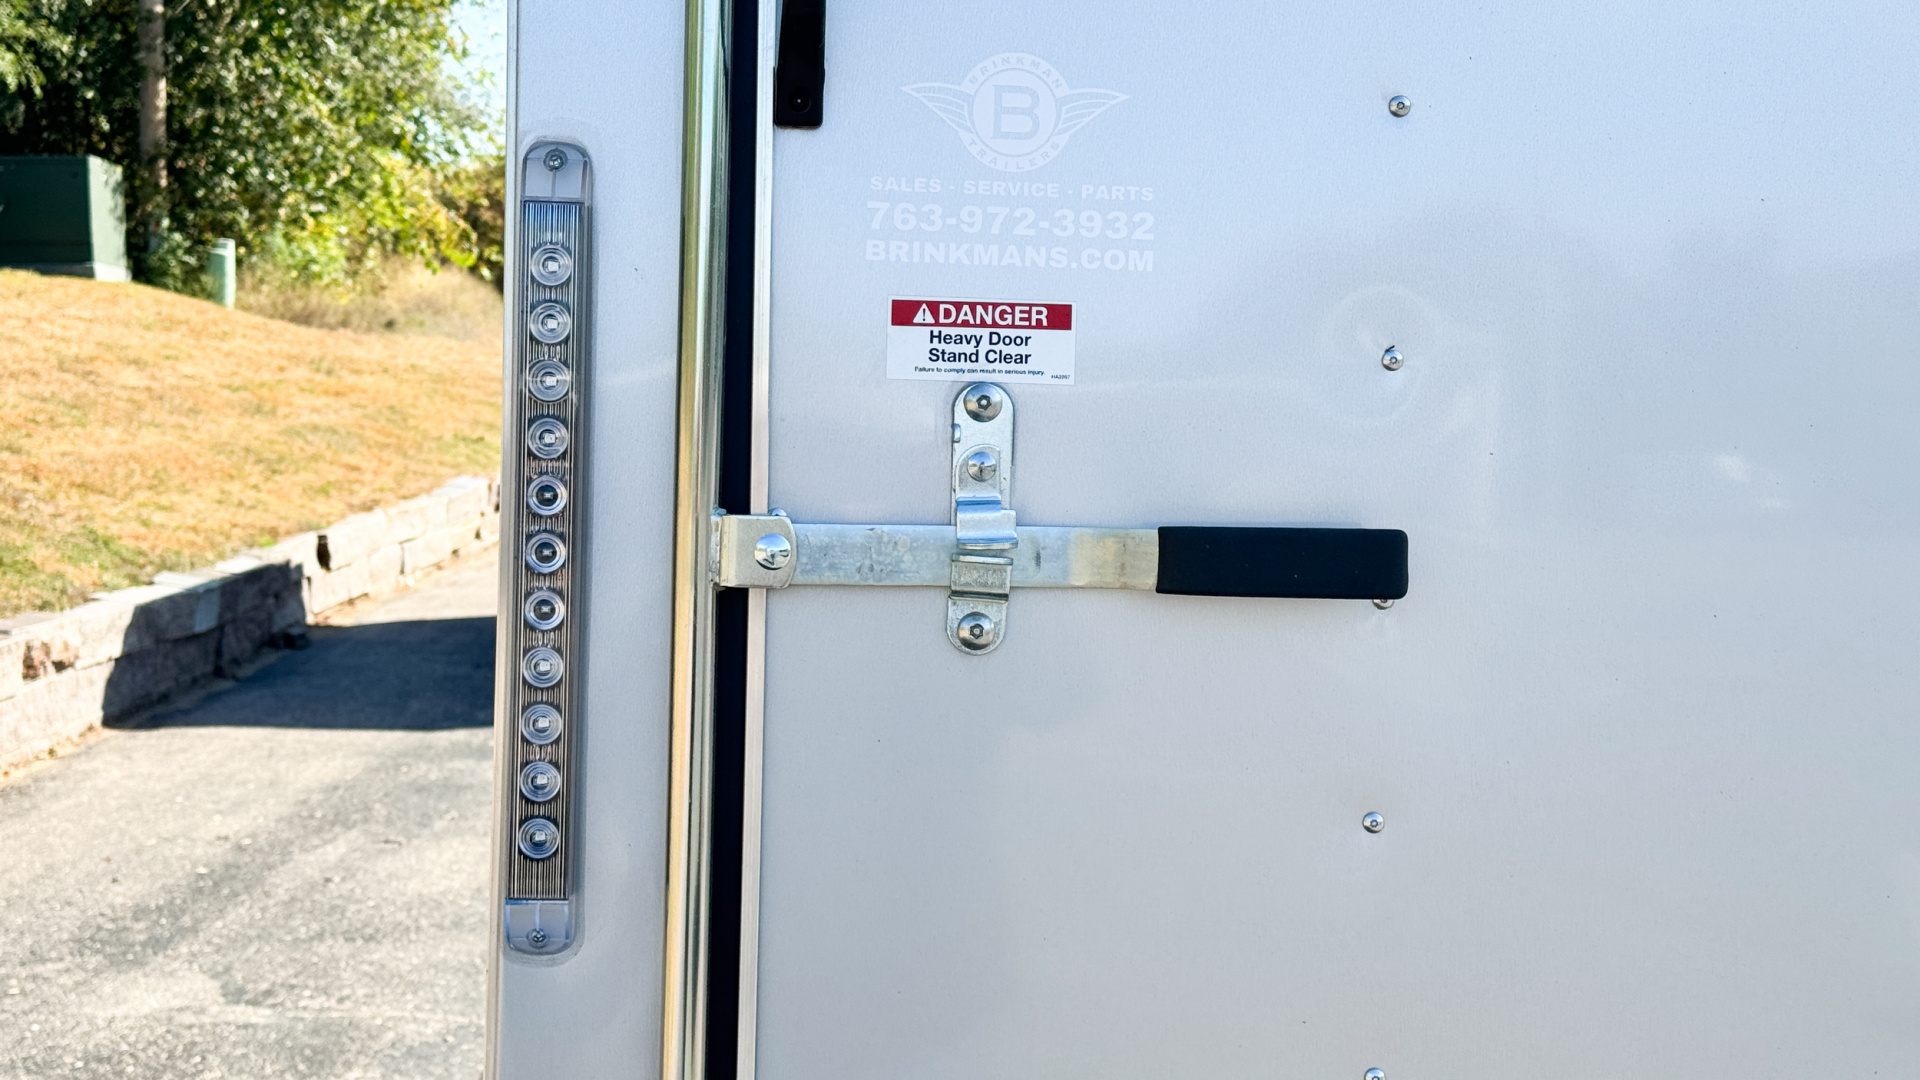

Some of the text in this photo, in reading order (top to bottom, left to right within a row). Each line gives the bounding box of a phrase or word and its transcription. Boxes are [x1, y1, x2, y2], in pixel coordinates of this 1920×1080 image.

[968, 55, 1063, 89] BRINKMAN
[991, 84, 1041, 140] B
[967, 138, 1059, 170] TRAILERS
[870, 176, 942, 193] SALES
[963, 180, 1060, 198] SERVICE
[1081, 184, 1155, 201] PARTS
[866, 200, 1155, 241] 763-972-3932
[865, 239, 1154, 272] BRINKMANS.COM
[938, 303, 1049, 327] DANGER
[929, 329, 1032, 349] Heavy Door
[928, 348, 1032, 365] Stand Clear
[943, 367, 966, 375] comply
